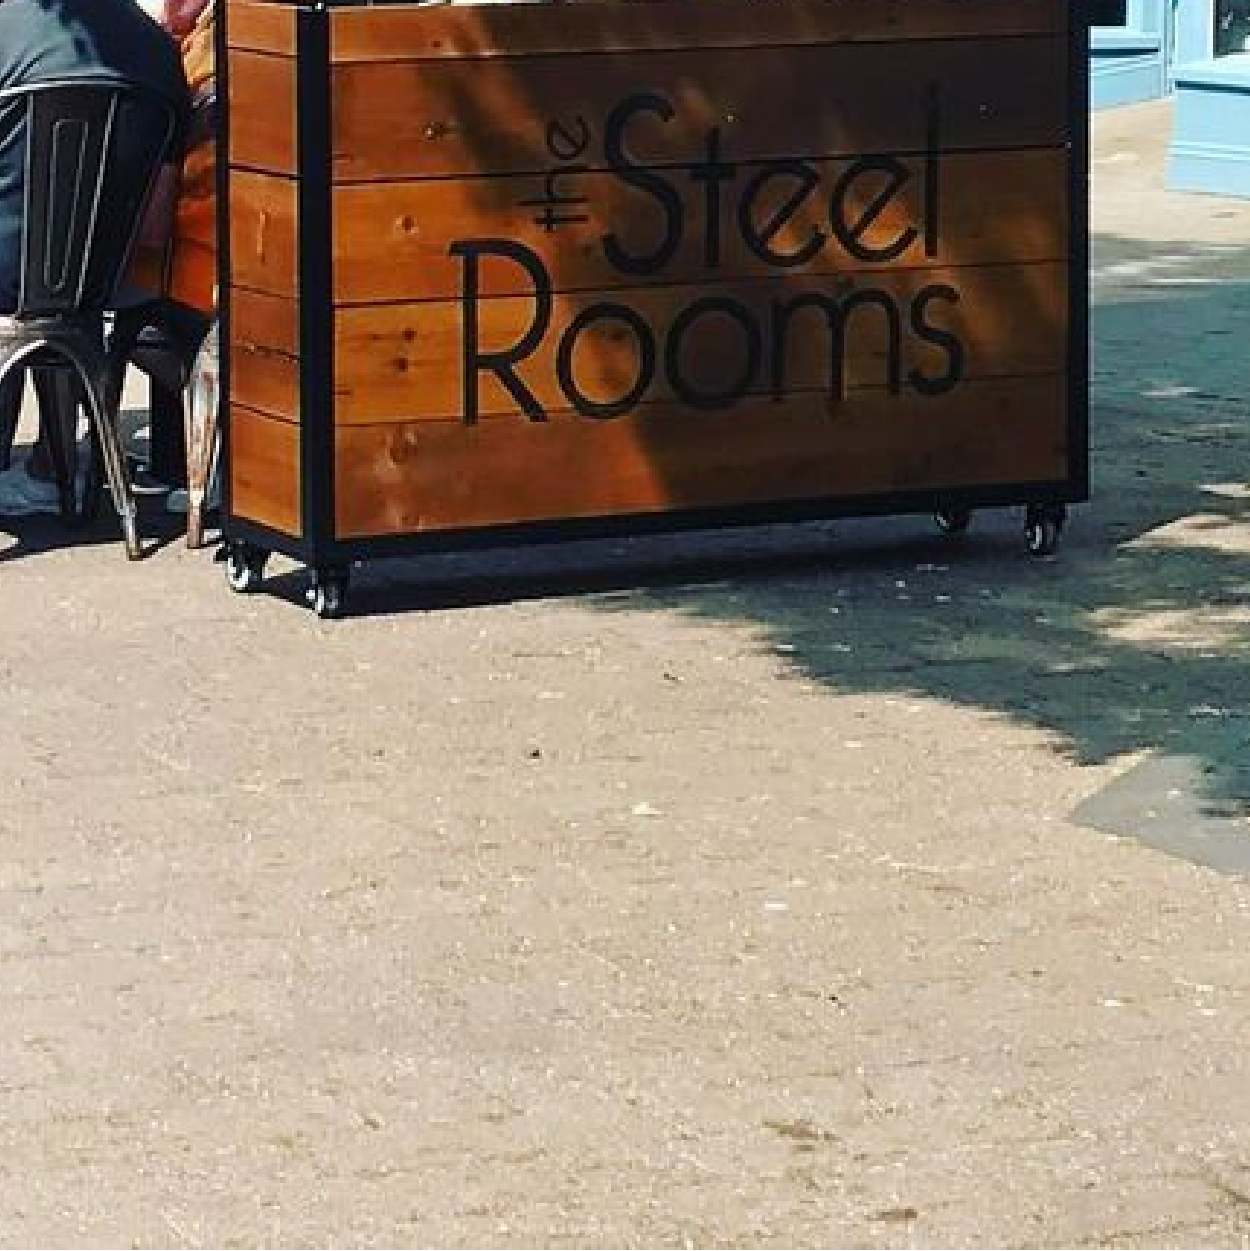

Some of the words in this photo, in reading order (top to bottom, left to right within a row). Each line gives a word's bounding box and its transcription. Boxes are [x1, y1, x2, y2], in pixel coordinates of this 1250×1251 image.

[518, 115, 591, 235] the
[603, 83, 940, 275] Steel
[450, 236, 964, 426] Rooms
